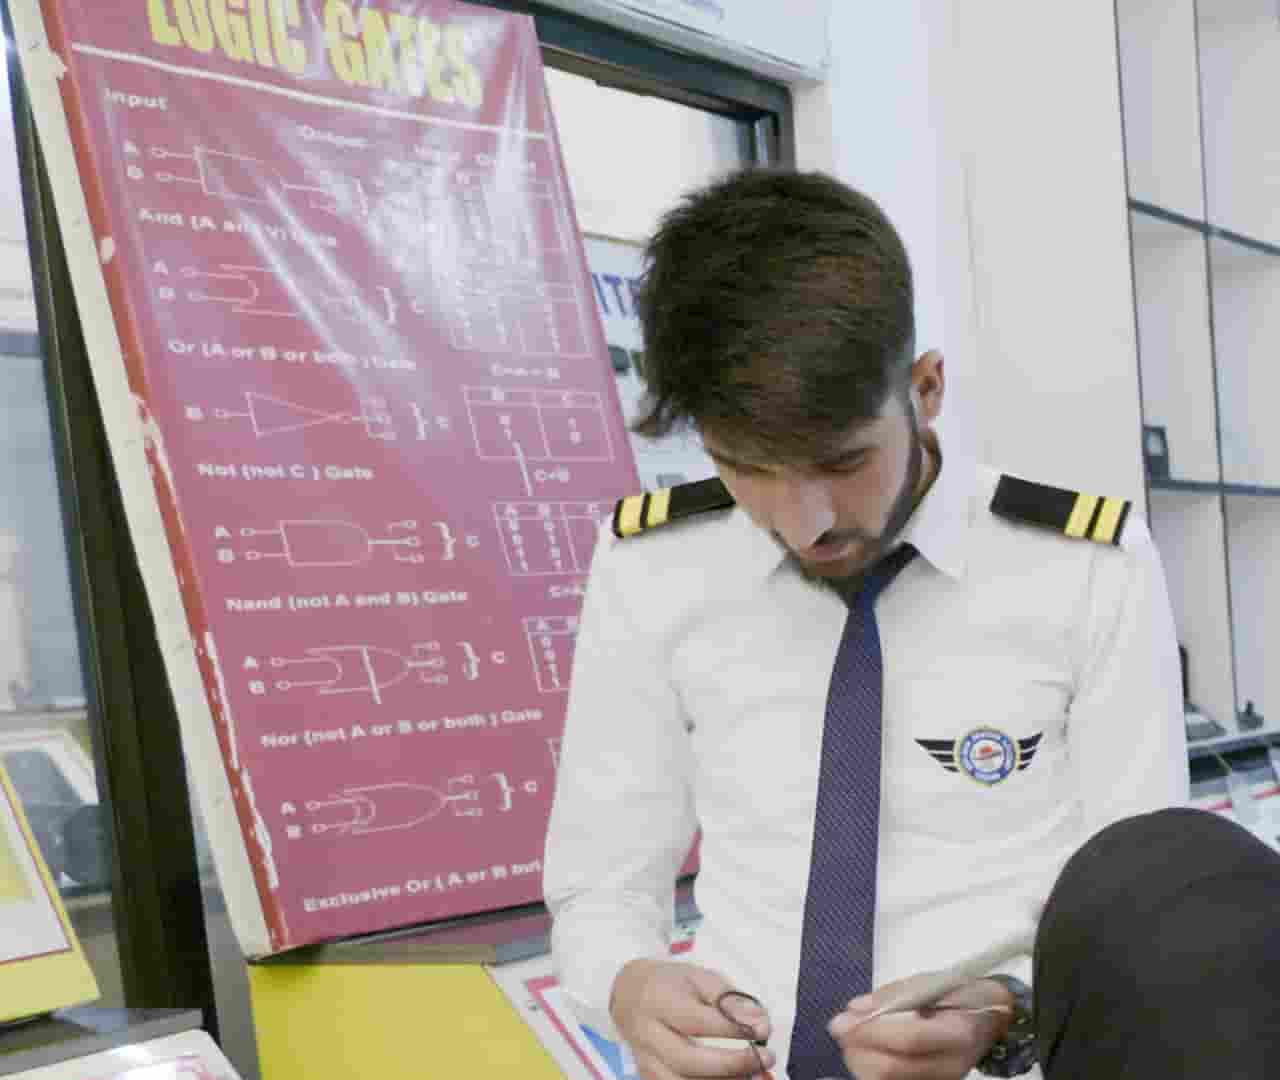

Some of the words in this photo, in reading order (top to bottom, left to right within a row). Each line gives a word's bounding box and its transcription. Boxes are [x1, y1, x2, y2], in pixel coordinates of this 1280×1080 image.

[104, 87, 168, 110] Input
[196, 462, 237, 479] Not
[241, 463, 286, 482] (not
[324, 464, 374, 481] Gate
[225, 591, 282, 612] Nand
[423, 588, 469, 604] Gate
[260, 731, 298, 750] Nor
[442, 711, 486, 730] both
[501, 707, 544, 725] Gate
[303, 882, 402, 914] Exclusive
